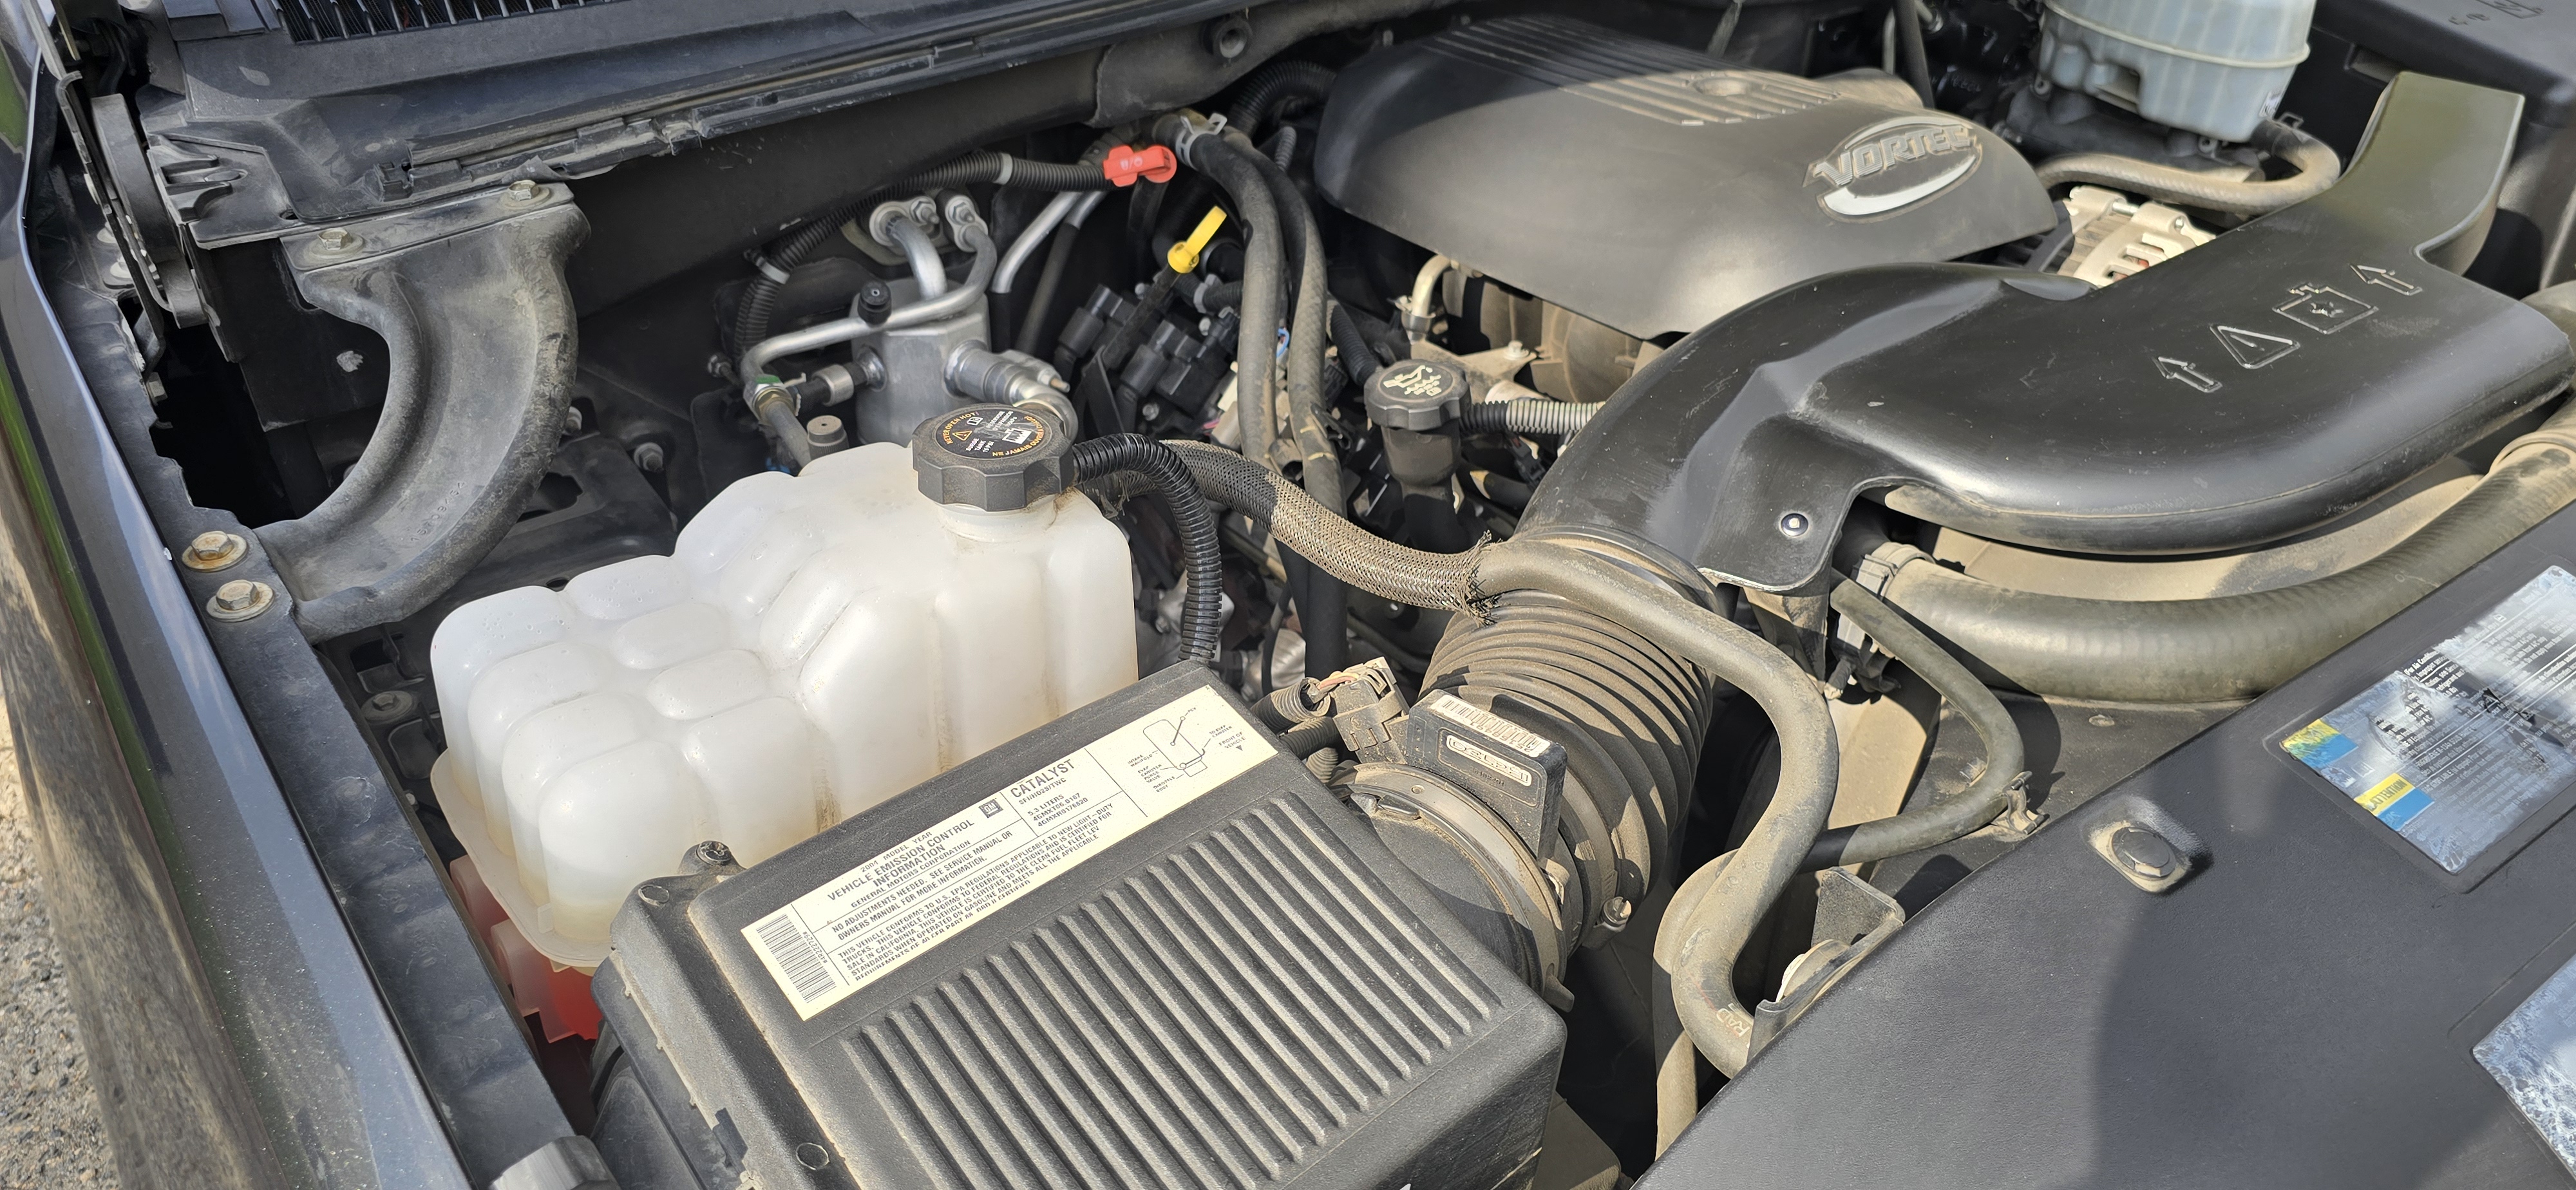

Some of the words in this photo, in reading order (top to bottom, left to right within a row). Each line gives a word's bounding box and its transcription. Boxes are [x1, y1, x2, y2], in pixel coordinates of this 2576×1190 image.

[1815, 124, 1975, 186] VORTEC
[945, 418, 961, 430] OPEN
[1005, 444, 1032, 455] JAMAIS
[1218, 735, 1236, 746] FRONT
[1224, 736, 1247, 749] VEHICLE
[1448, 738, 1530, 783] DELPHI
[1010, 759, 1075, 798] CATALYST
[2369, 779, 2408, 811] ATTENTION
[982, 799, 1000, 815] GM
[1027, 808, 1040, 816] 5.3
[1039, 794, 1065, 810] LITERS
[827, 873, 873, 901] VEHICLE
[874, 844, 926, 876] EMISSION
[927, 819, 975, 847] CONTROL
[860, 860, 878, 873] 2004
[883, 844, 910, 860] MODEL
[911, 831, 933, 844] YEAR
[872, 844, 946, 887] INFORMATION
[831, 923, 844, 933] NO
[844, 894, 897, 927] ADJUSTMENTS
[896, 878, 928, 898] NEEDED.
[929, 867, 944, 879] SEE
[943, 852, 974, 871] SERVICE
[972, 836, 1003, 855] MANUAL
[1001, 831, 1013, 840] OR
[837, 946, 856, 959] THIS
[855, 929, 886, 949] VEHICLE
[886, 907, 925, 932] CONFORMS
[934, 894, 951, 904] U.S.
[950, 885, 965, 896] EPA
[964, 860, 1010, 888] REGULATIONS
[1010, 838, 1048, 863] APPLICABLE
[1057, 825, 1073, 836] NEW
[842, 945, 874, 964] TRUCKS.
[875, 933, 894, 945] THIS
[893, 916, 923, 935] VEHICLE
[923, 895, 961, 920] CONFORMS
[960, 889, 971, 898] TO
[971, 871, 1001, 892] FEDERAL
[1000, 848, 1045, 876] REGULATIONS
[1045, 840, 1059, 851] AND
[1067, 818, 1099, 838] CERTIFIED
[1097, 811, 1112, 822] FOR
[851, 887, 887, 908] GENERAL
[886, 868, 919, 889] MOTORS
[920, 840, 971, 870] CORPORATION
[837, 919, 870, 941] OWNERS
[869, 903, 902, 923] MANUAL
[900, 893, 917, 905] FOR
[916, 881, 938, 897] MORE
[937, 855, 987, 885] INFORMATION.
[846, 956, 866, 970] SALE
[865, 952, 875, 960] IN
[875, 929, 919, 954] CALIFORNIA.
[918, 917, 936, 929] THIS
[935, 901, 964, 920] VEHICLE
[963, 896, 972, 905] IS
[972, 878, 1006, 900] CERTIFIED
[1015, 864, 1030, 874] THE
[1029, 853, 1051, 867] CLEAN
[1050, 844, 1068, 855] FUEL
[1067, 832, 1086, 846] FLEET
[1086, 825, 1099, 835] LEV
[851, 949, 894, 976] STANDARDS
[893, 936, 916, 952] WHEN
[916, 916, 952, 939] OPERATED
[952, 910, 964, 918] ON
[964, 891, 998, 912] GASOLINE
[998, 882, 1012, 894] AND
[1012, 869, 1035, 885] MEETS
[1035, 863, 1048, 873] ALL
[1046, 854, 1061, 864] THE
[1061, 833, 1099, 857] APPLICABLE
[945, 917, 963, 930] PART
[1716, 1008, 1751, 1038] RAD
